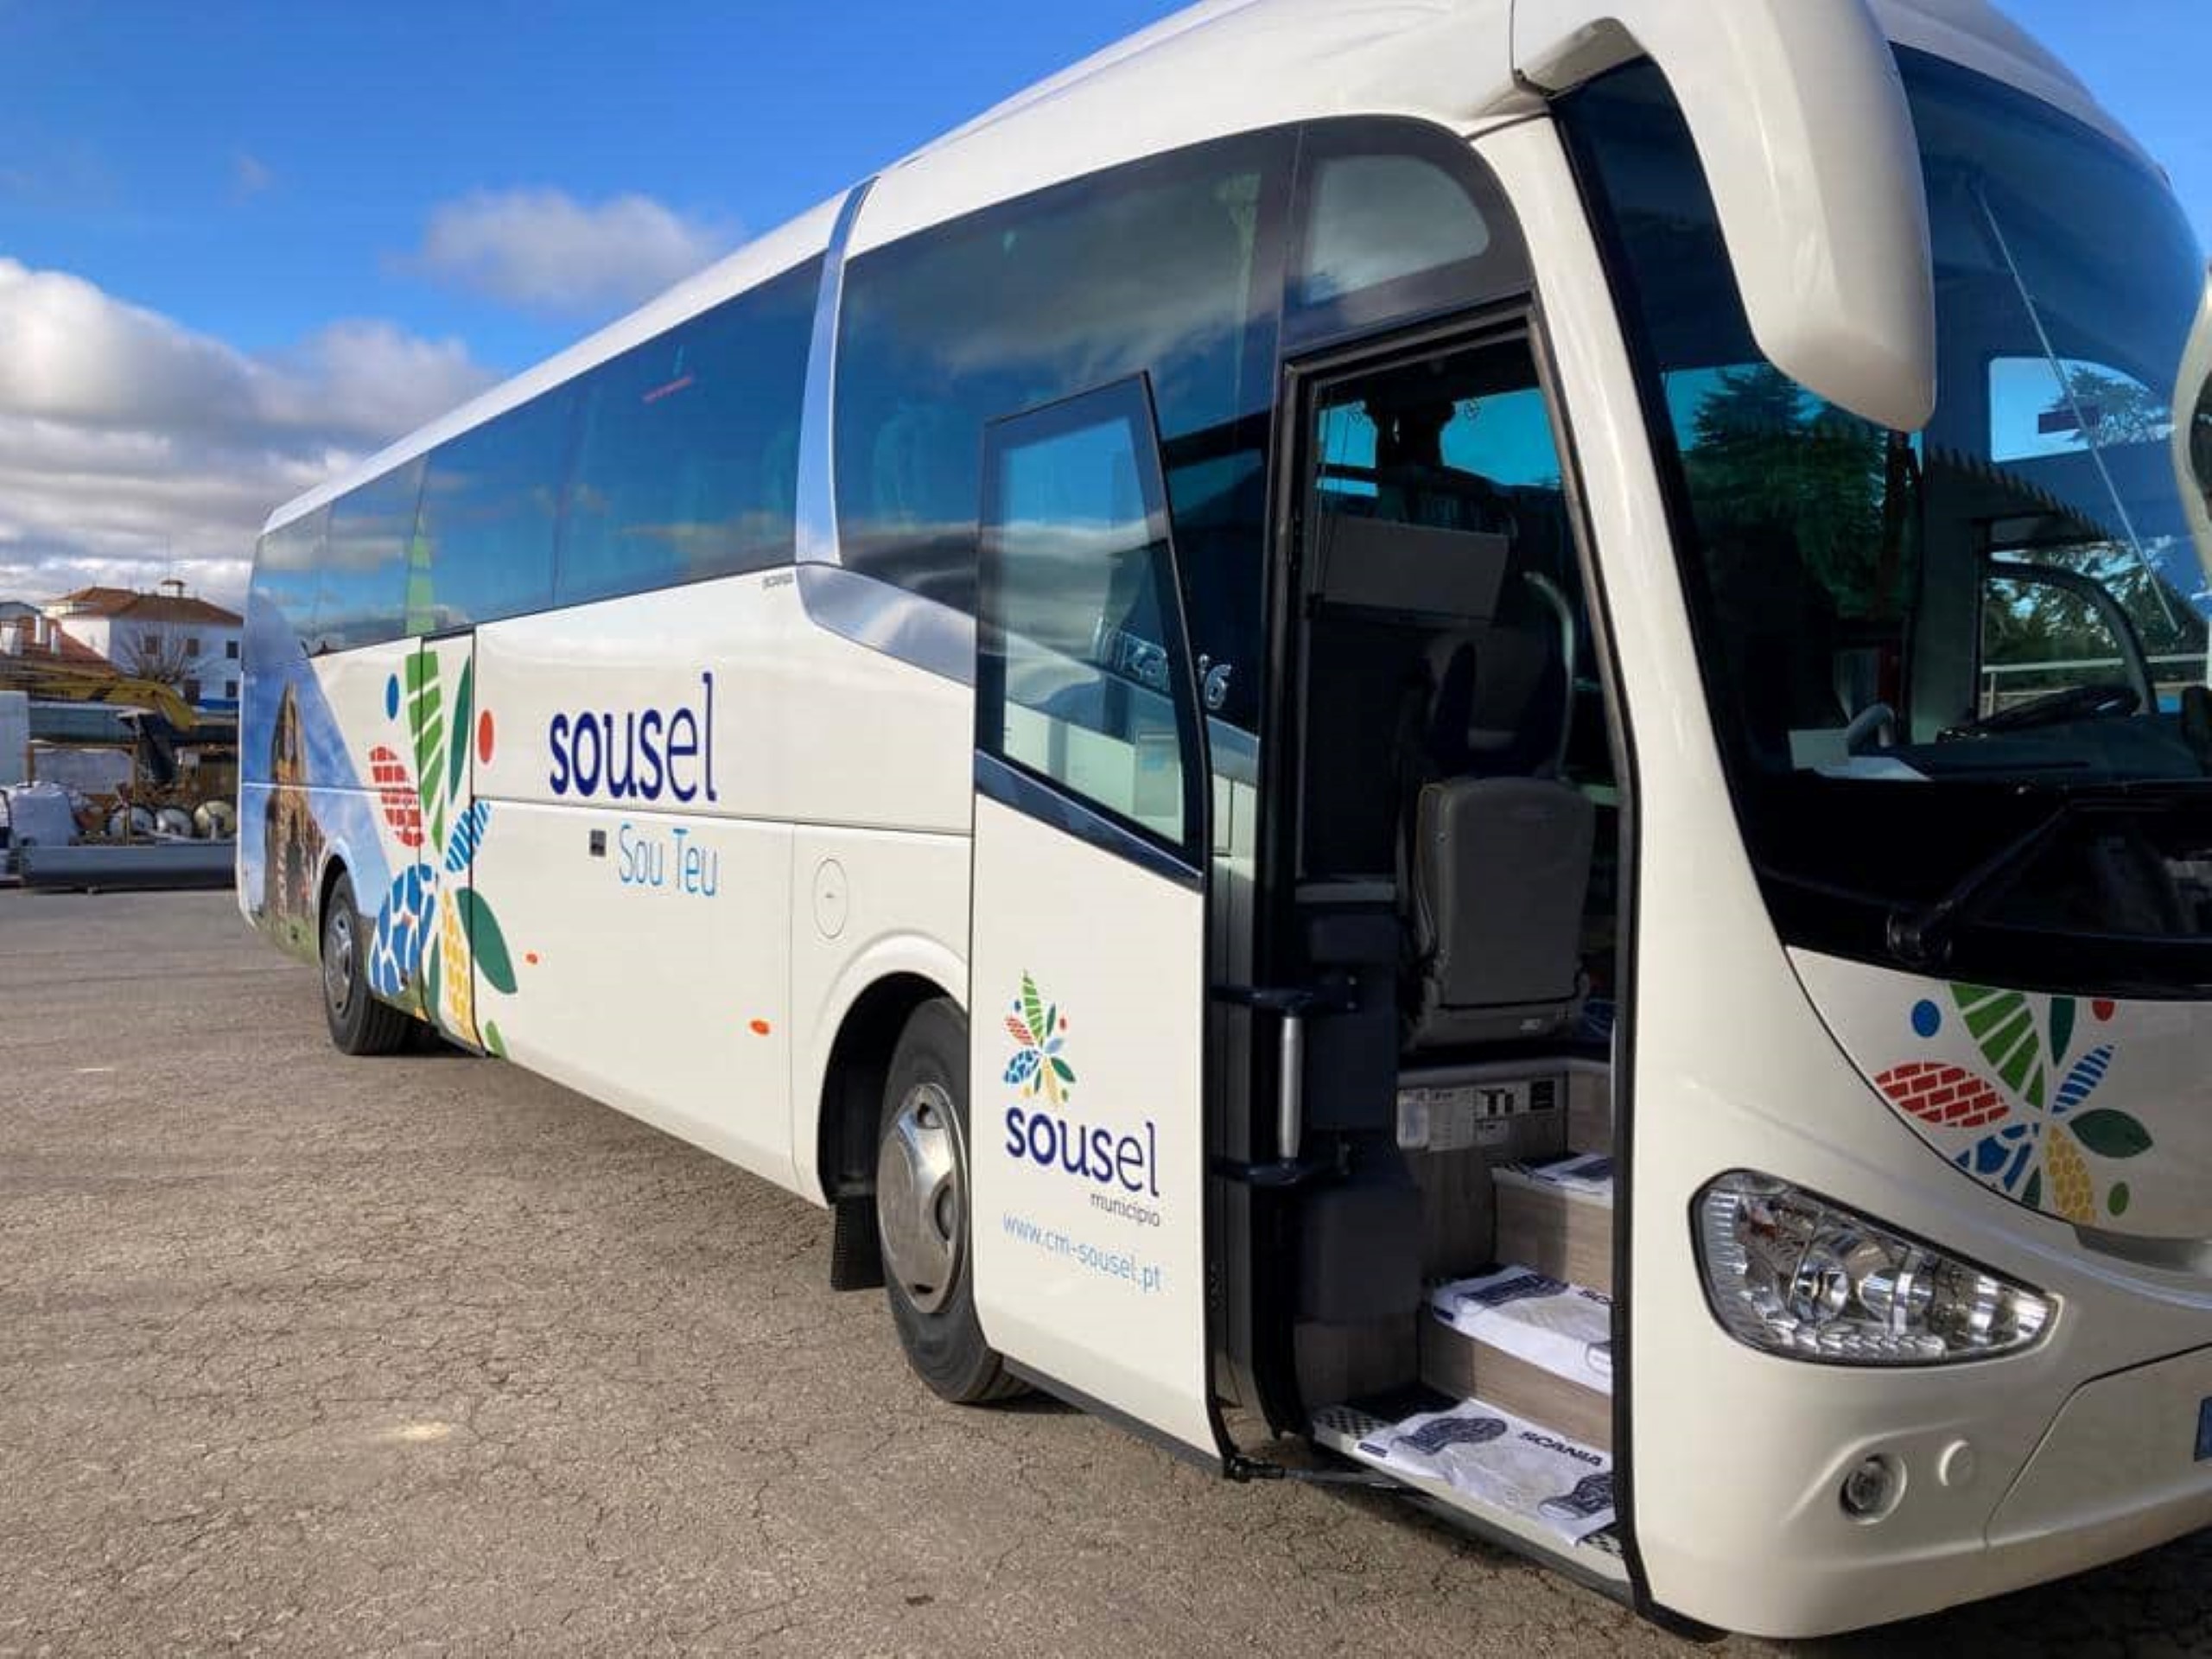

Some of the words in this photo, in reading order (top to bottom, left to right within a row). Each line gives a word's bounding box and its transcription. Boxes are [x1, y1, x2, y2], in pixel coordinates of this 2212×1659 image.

[550, 671, 717, 804] sousel
[619, 822, 664, 887] Sou
[671, 827, 717, 898] Teu
[1006, 1107, 1160, 1198] sousel
[1003, 1212, 1161, 1294] www.cm-sousel.pt
